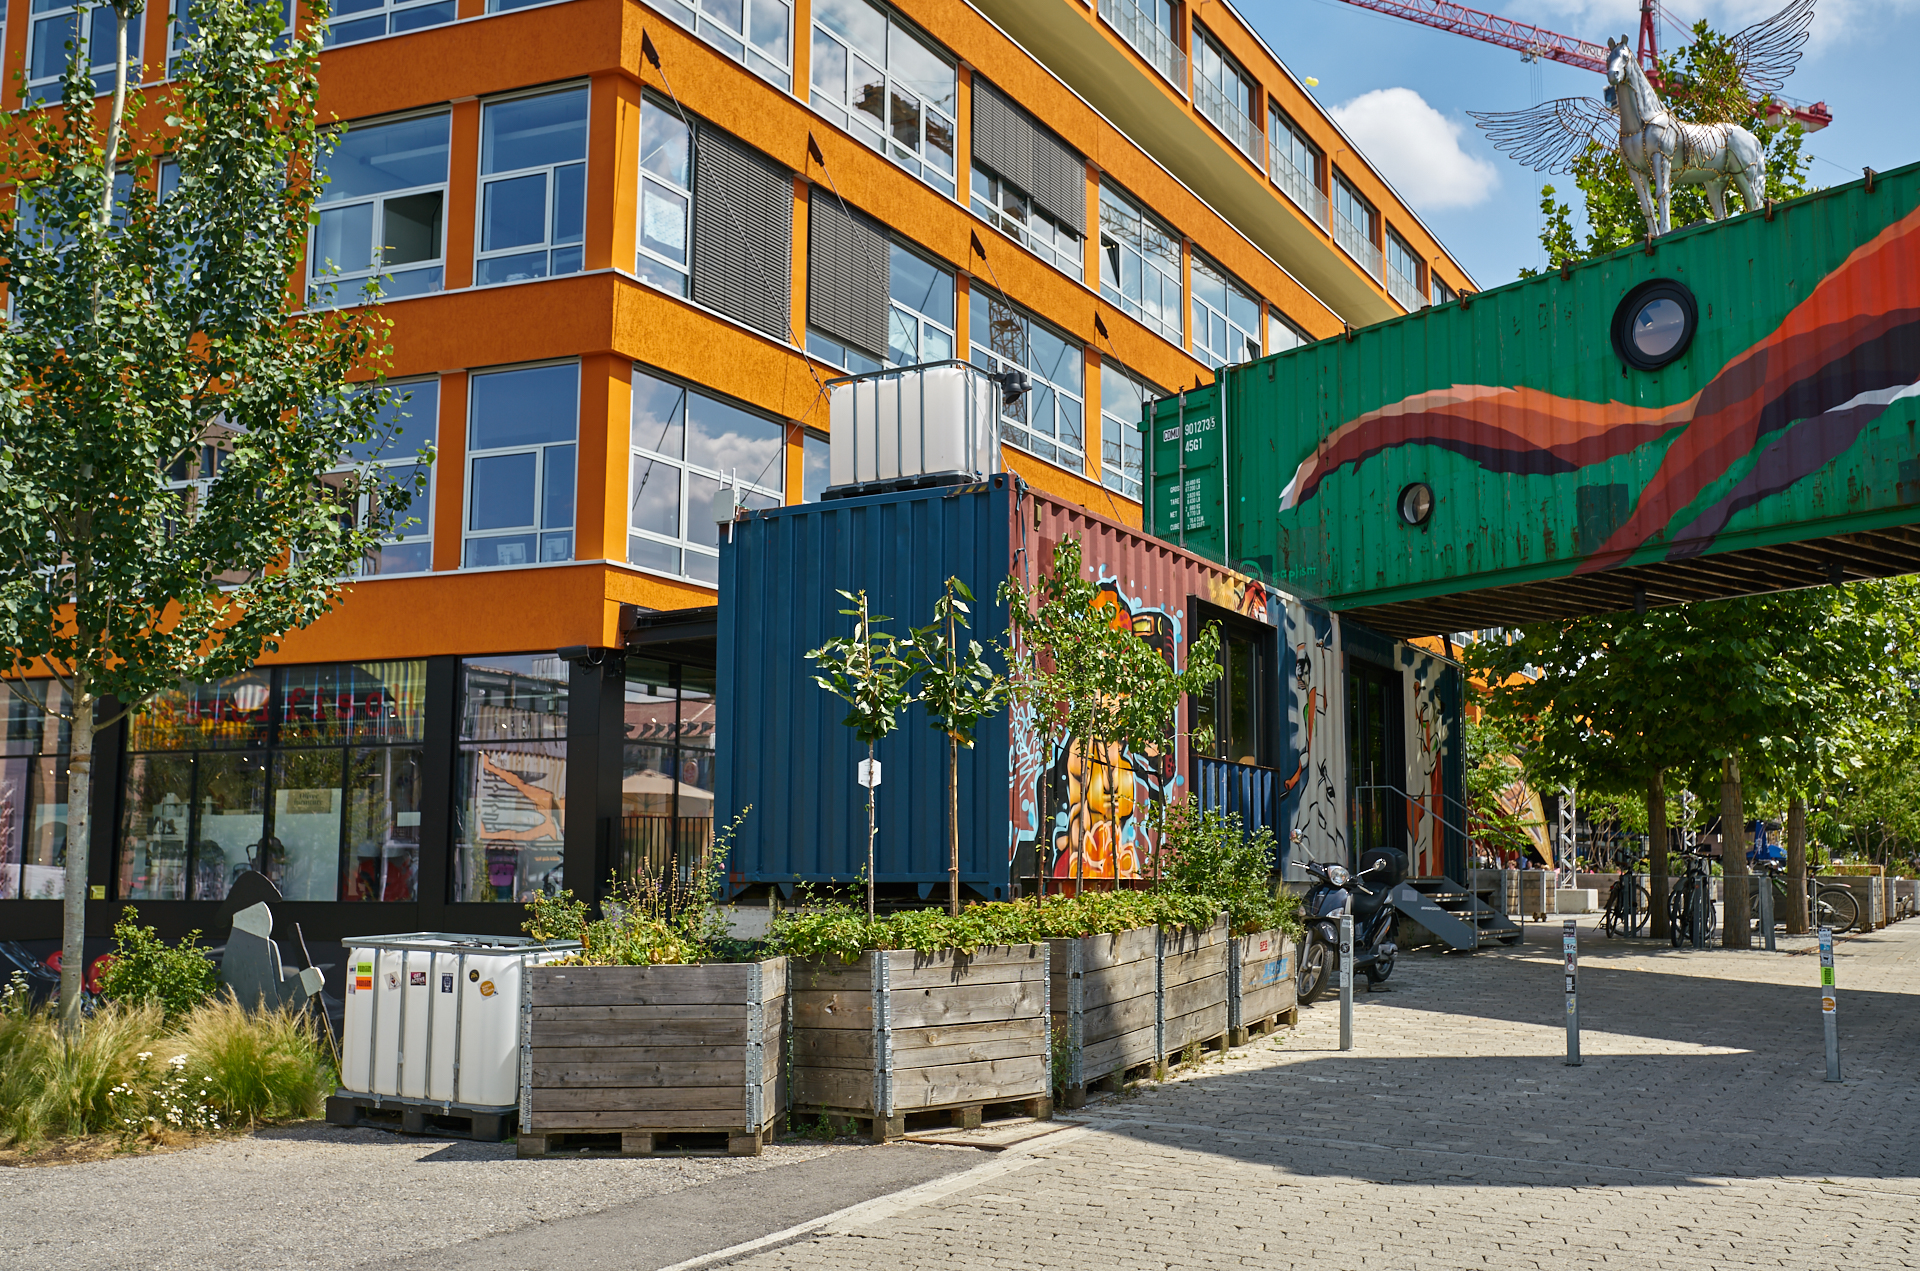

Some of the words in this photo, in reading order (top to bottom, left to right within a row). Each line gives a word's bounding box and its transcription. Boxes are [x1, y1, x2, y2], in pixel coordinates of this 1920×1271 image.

[1185, 437, 1202, 453] 45G1
[1169, 485, 1180, 493] GROS
[1170, 498, 1180, 506] TARE
[1170, 510, 1178, 518] NET
[1170, 522, 1180, 531] CUBE
